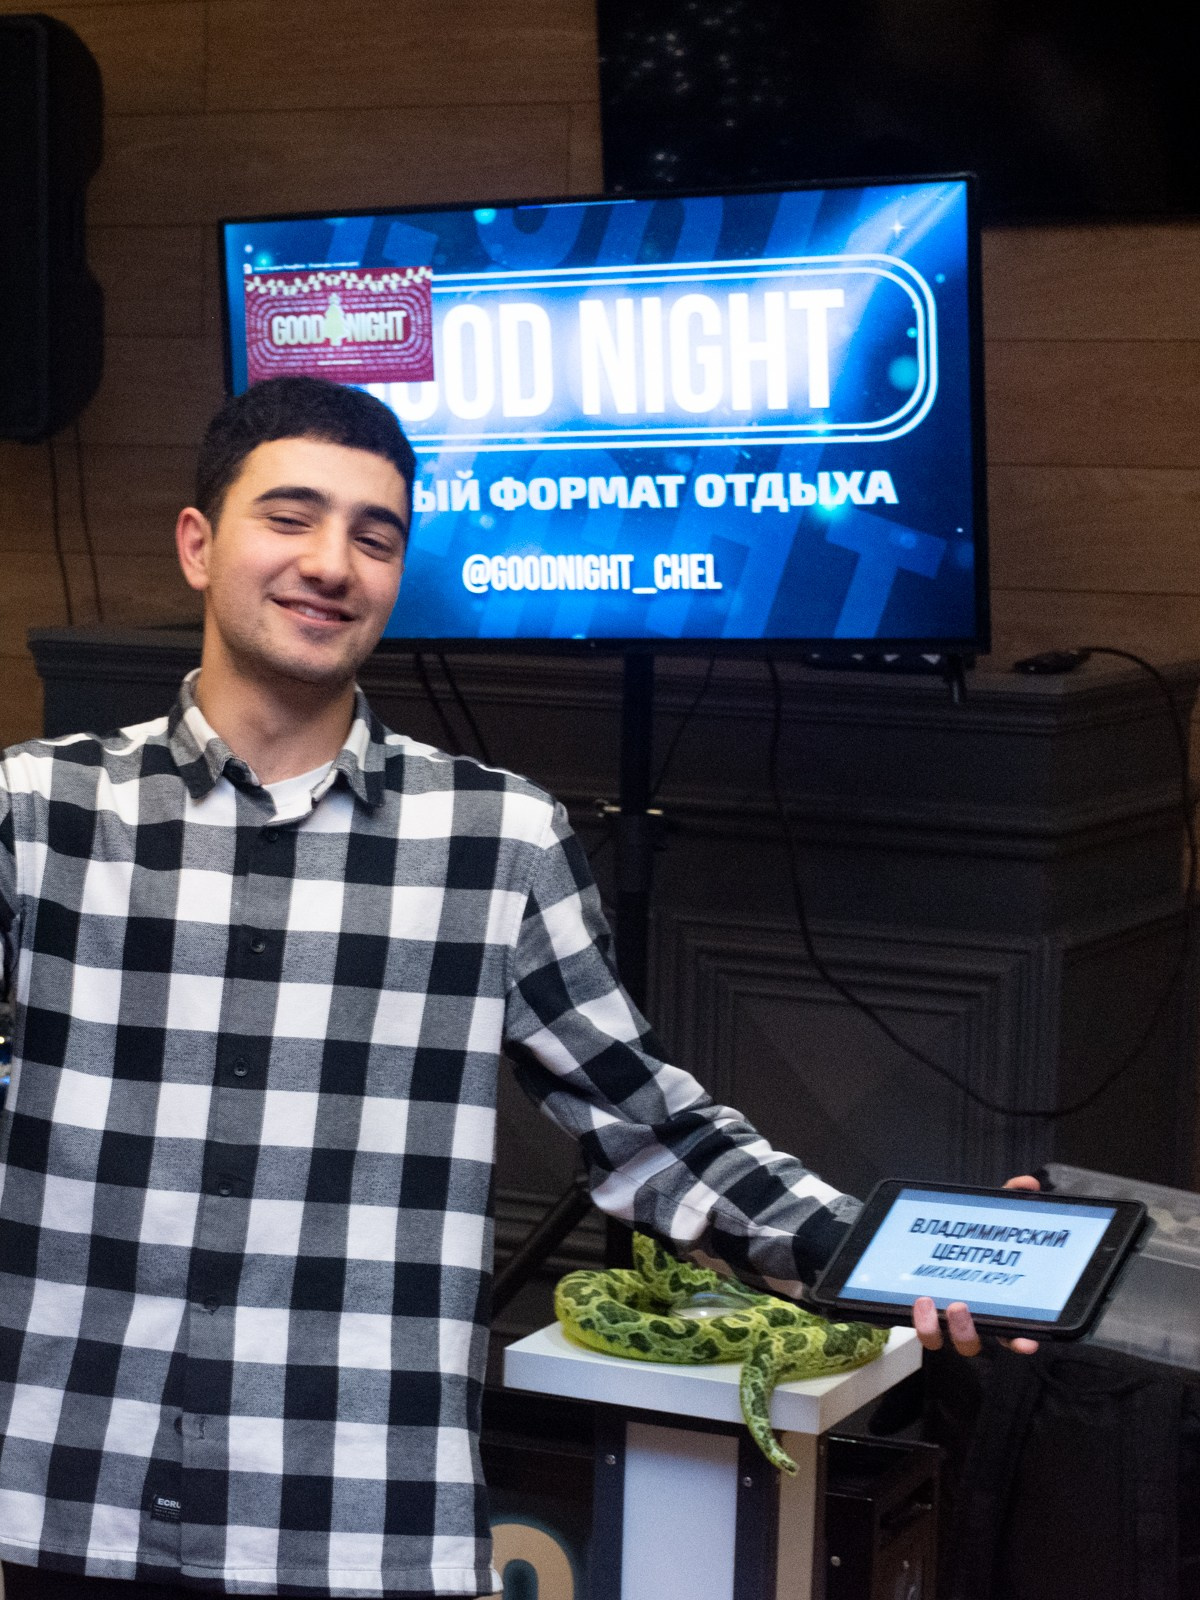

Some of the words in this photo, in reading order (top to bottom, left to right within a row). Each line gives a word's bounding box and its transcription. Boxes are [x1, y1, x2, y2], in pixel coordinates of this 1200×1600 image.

[272, 314, 325, 345] GOOD
[346, 310, 407, 343] NIGHT
[367, 302, 553, 421] OD
[579, 289, 845, 415] NIGHT
[413, 470, 480, 511] ЫЙ
[489, 475, 686, 511] ФОРМАТ
[695, 471, 898, 512] ОТДЫХА
[462, 553, 722, 594] @GOODNIGHT_CHEL
[909, 1217, 1071, 1248] ВЛАДИМИРСКИЙ
[930, 1243, 1022, 1267] ЦЕНТРАЛ
[911, 1264, 982, 1283] МИХАИЛ
[980, 1272, 1025, 1286] КРУГ
